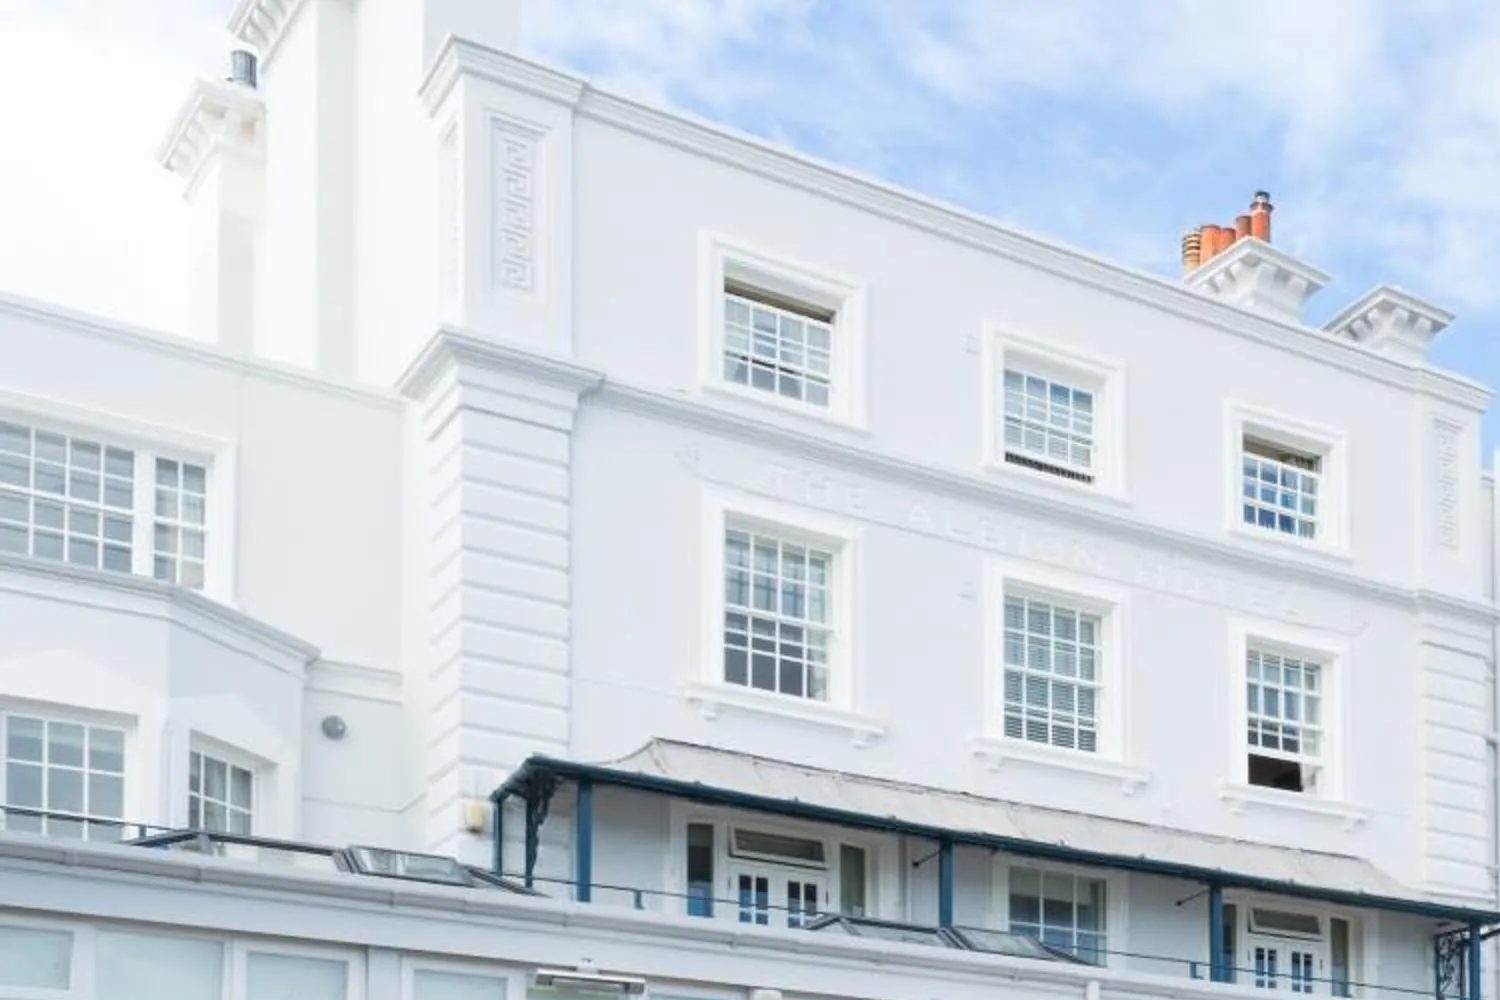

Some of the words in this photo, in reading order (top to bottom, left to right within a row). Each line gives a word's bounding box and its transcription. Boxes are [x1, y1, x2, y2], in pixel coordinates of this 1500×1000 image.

[768, 466, 865, 511] THE
[906, 500, 1103, 572] ALBION
[1137, 556, 1298, 618] HOTEL
